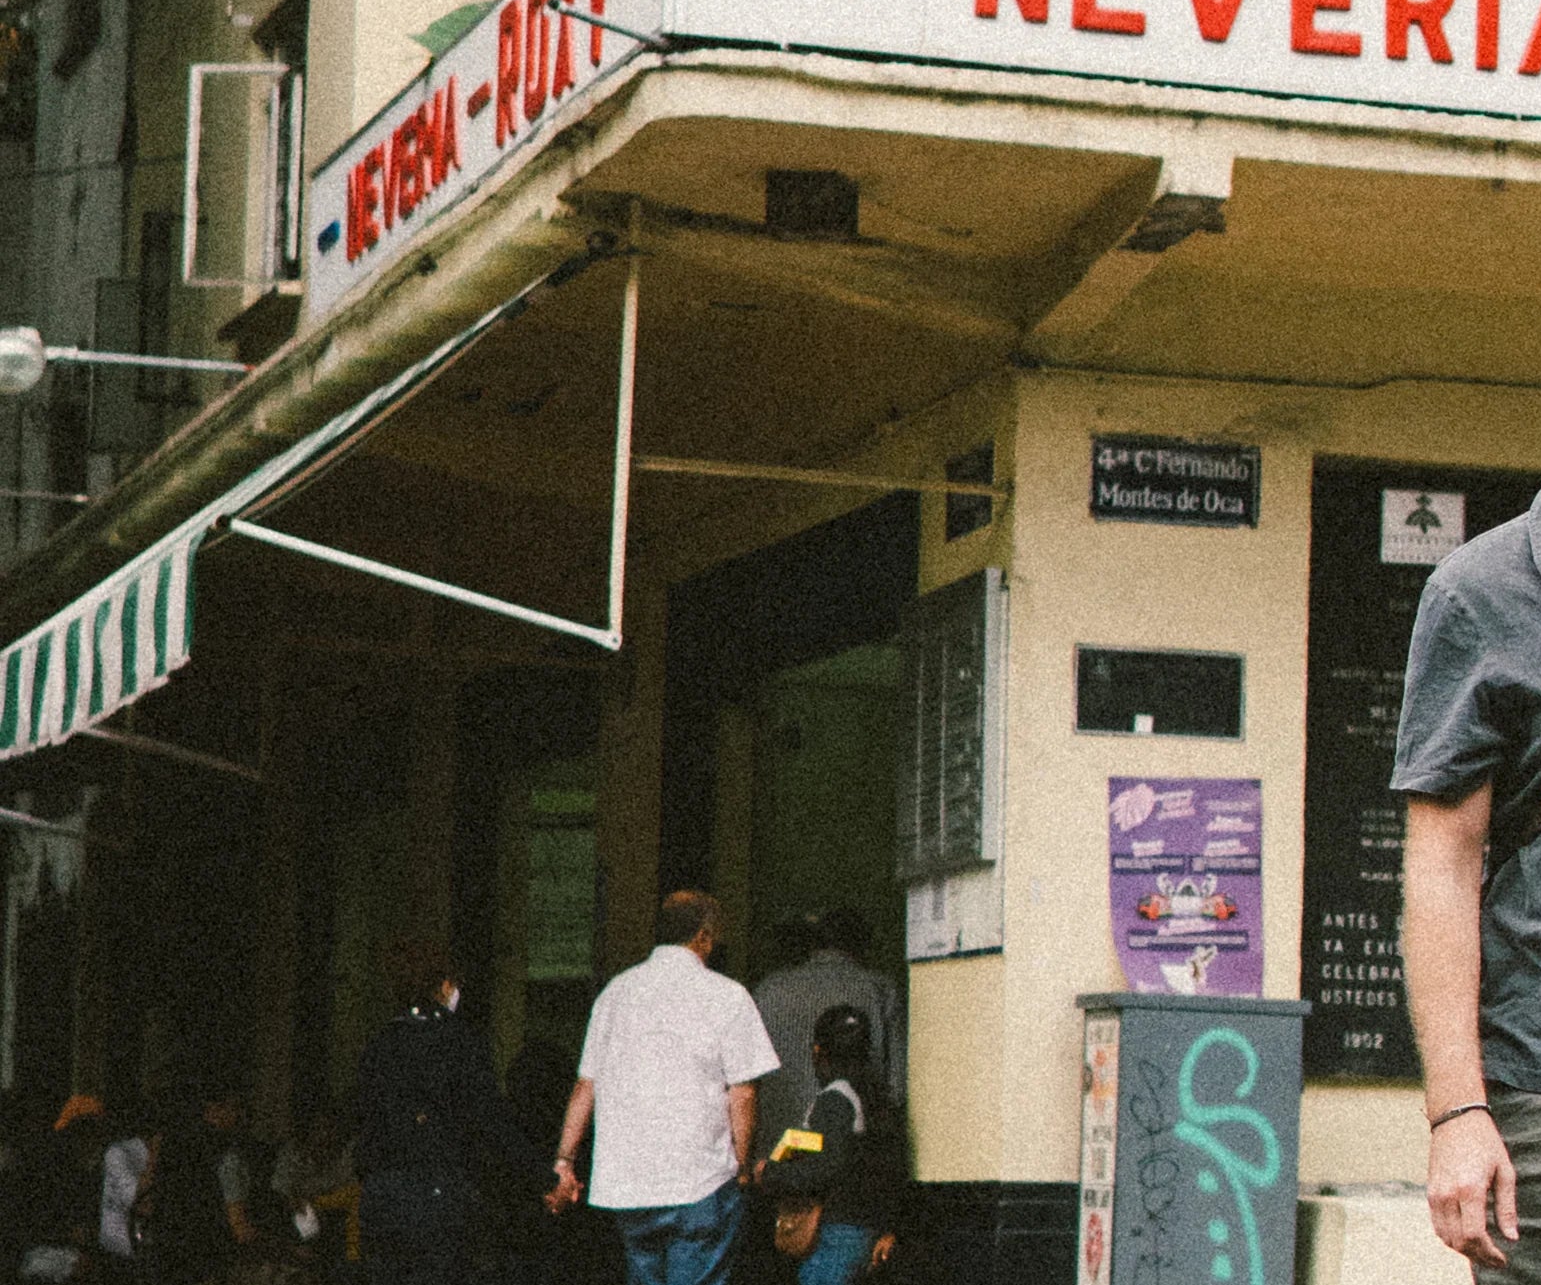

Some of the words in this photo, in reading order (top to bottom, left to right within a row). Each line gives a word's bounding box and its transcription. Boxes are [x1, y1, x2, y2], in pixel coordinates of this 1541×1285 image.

[1156, 451, 1250, 481] Fernando
[1098, 482, 1173, 508] Montes
[1176, 488, 1200, 511] de
[1203, 490, 1245, 514] Oca
